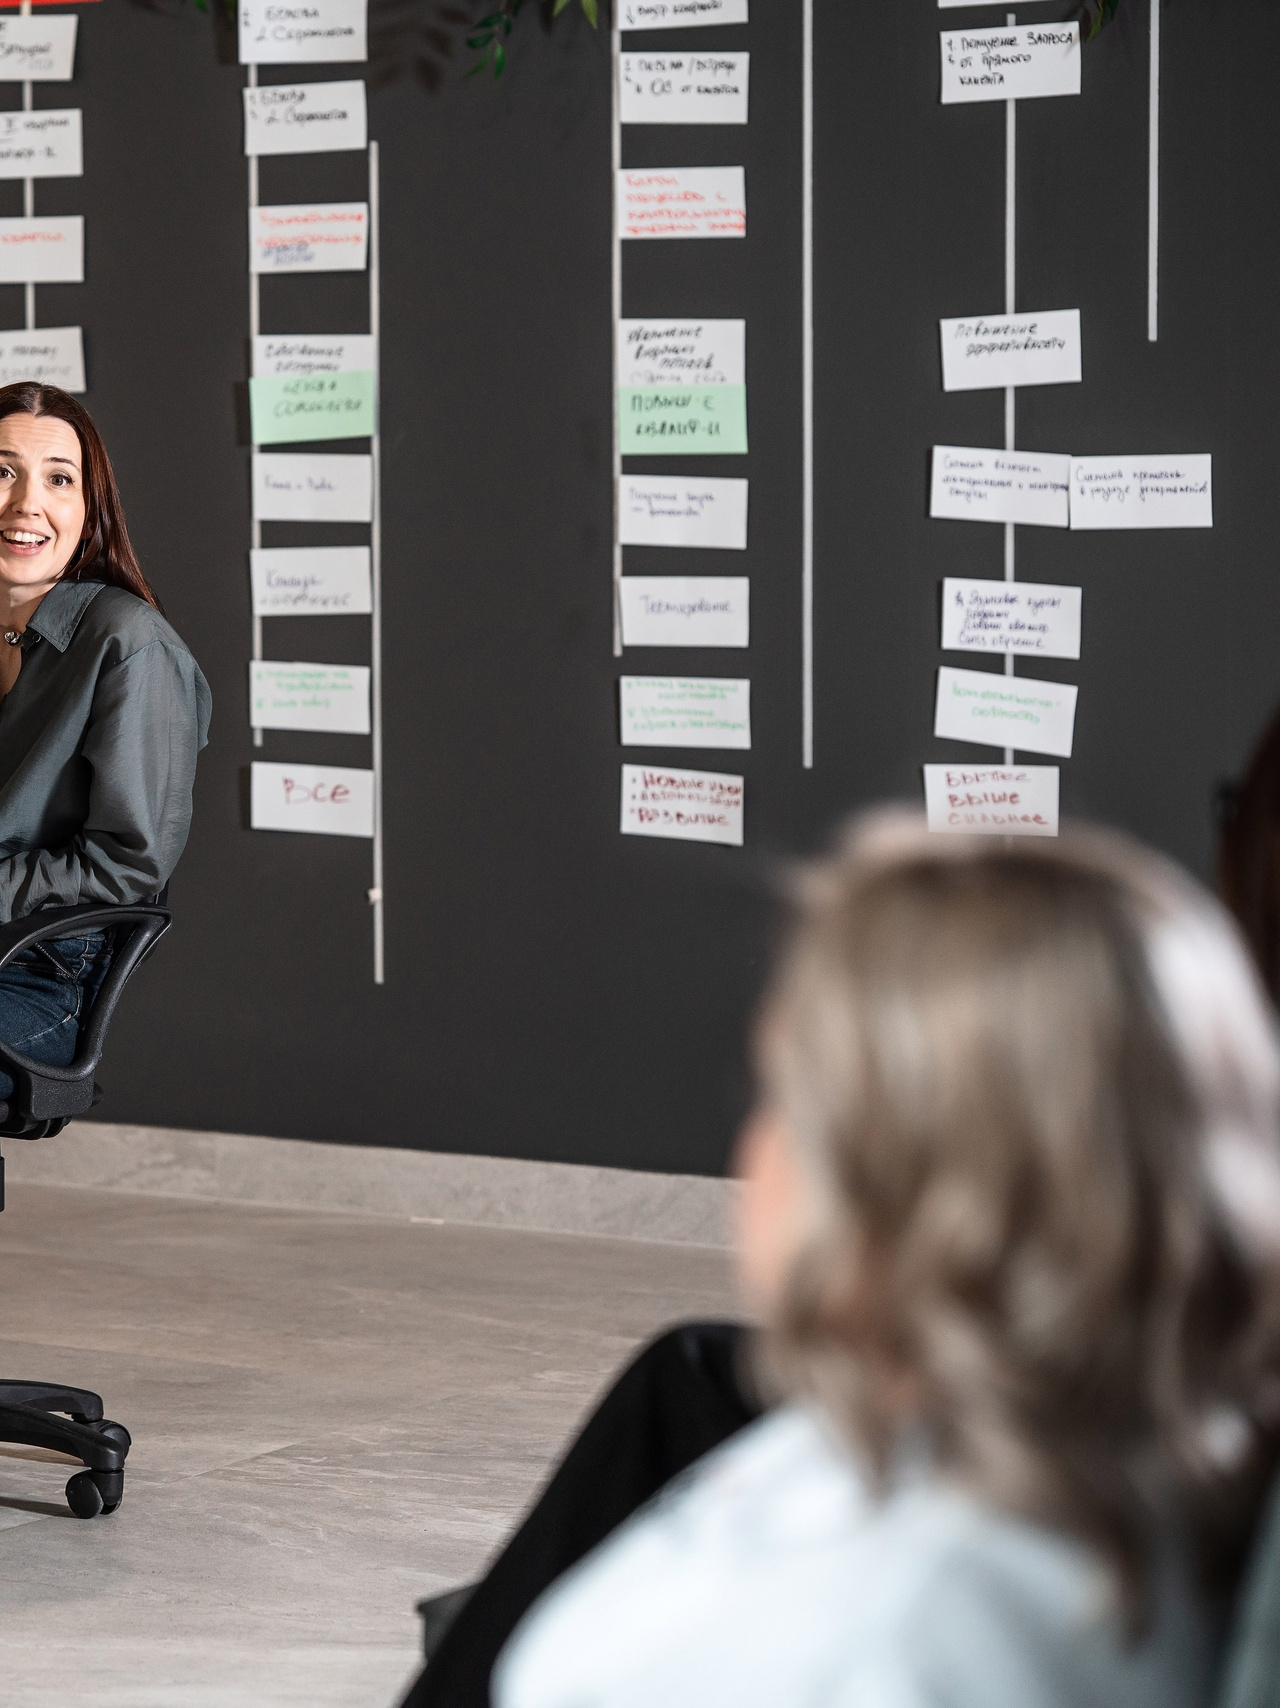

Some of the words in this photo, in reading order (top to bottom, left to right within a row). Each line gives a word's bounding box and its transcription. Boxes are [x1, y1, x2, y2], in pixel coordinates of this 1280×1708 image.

[961, 36, 1019, 54] Получение
[960, 56, 973, 68] от
[982, 53, 1032, 71] прямого
[955, 321, 1038, 339] Повышение
[1075, 465, 1123, 482] Система
[640, 595, 732, 618] Тестирование
